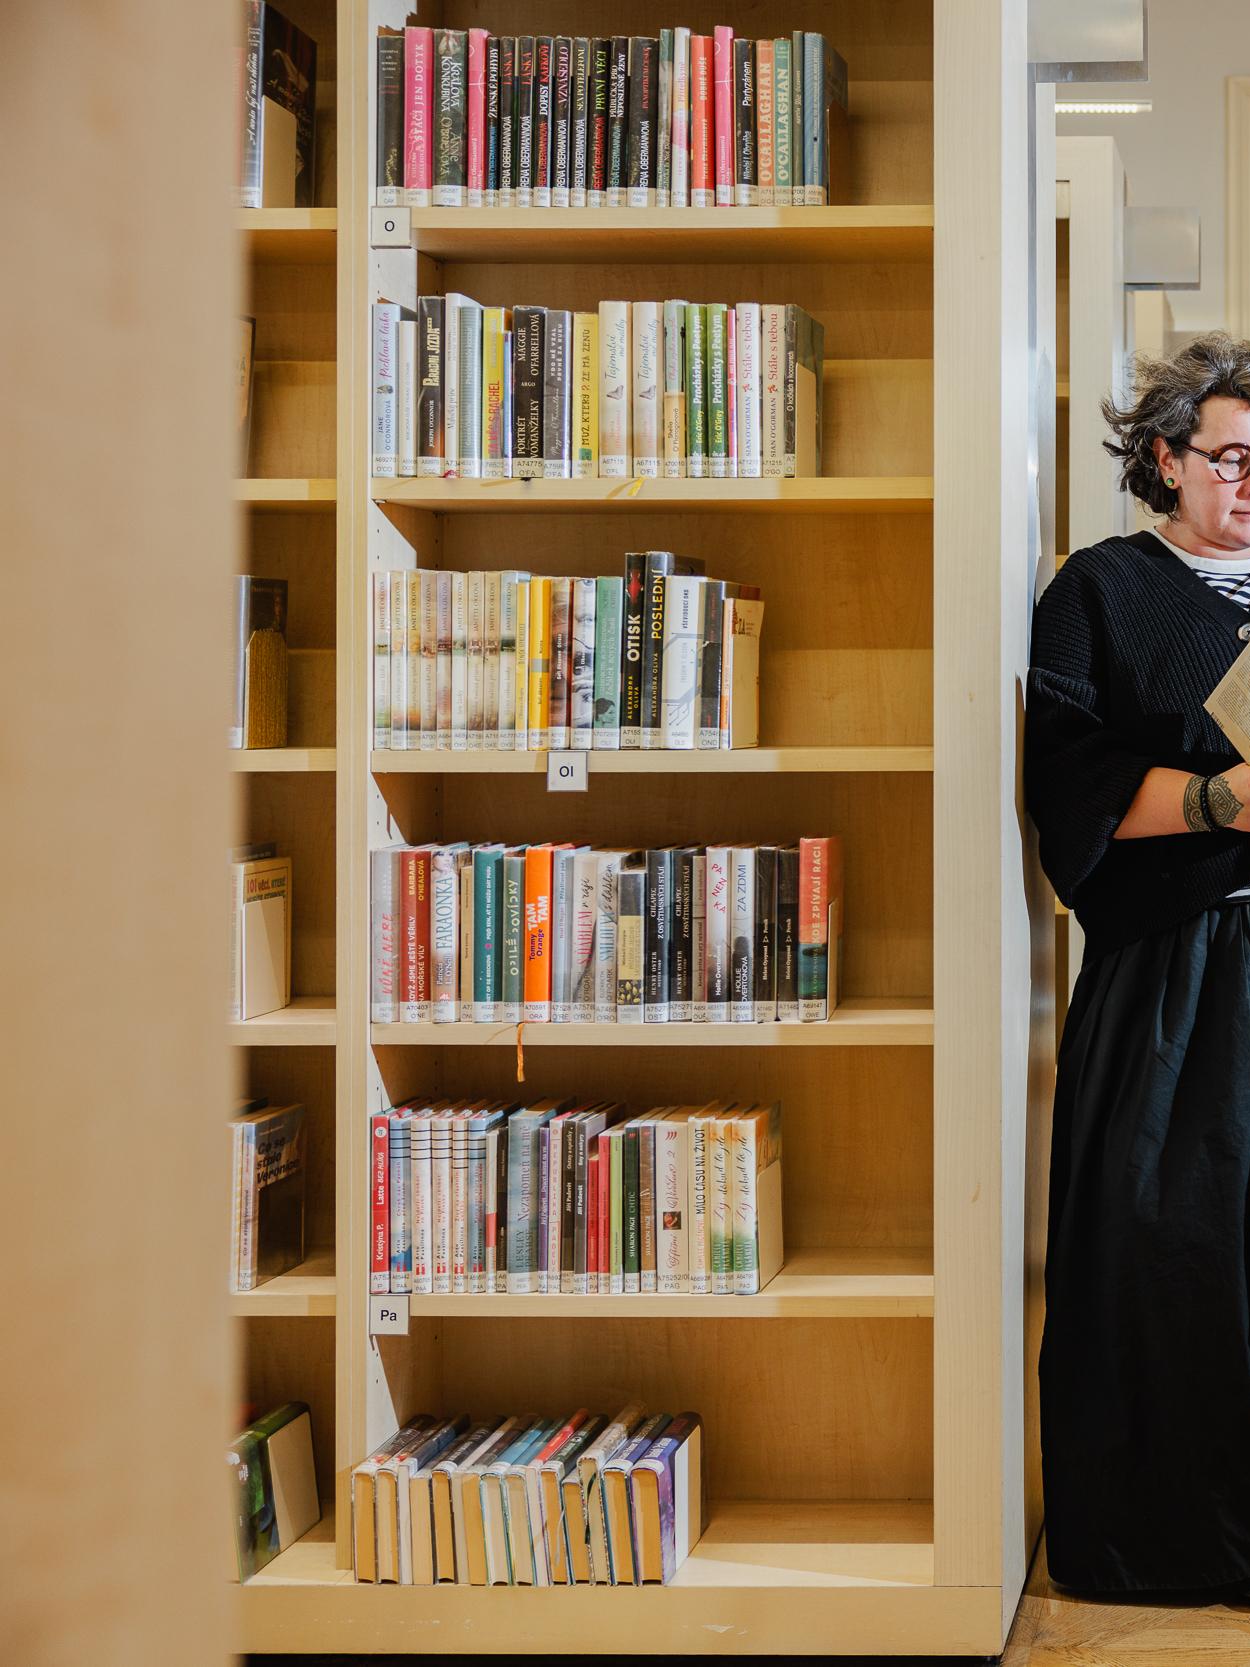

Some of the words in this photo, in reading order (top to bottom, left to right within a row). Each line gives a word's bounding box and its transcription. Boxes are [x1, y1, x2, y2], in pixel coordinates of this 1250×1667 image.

[415, 44, 423, 81] DOTYK
[489, 47, 498, 82] POHYBY
[415, 86, 424, 105] JEN
[742, 61, 752, 106] Partyzánem
[539, 85, 548, 116] DOPISY
[759, 63, 772, 180] O'CALLAGHAN
[777, 68, 789, 180] O'CALLAGHAN
[502, 169, 511, 188] RENA
[520, 169, 530, 188] RENA
[557, 169, 566, 188] RENA
[575, 169, 584, 188] RENA
[640, 171, 649, 188] RENA
[384, 220, 395, 232] O
[693, 314, 703, 349] Peetym
[712, 314, 723, 349] Peetym
[742, 311, 752, 342] tebou
[768, 313, 777, 344] tebou
[742, 352, 752, 379] Stále
[768, 353, 778, 380] Stále
[693, 358, 703, 404] Procházky
[712, 358, 723, 404] Procházky
[516, 416, 526, 454] PORTRÉT
[651, 568, 664, 639] POSLEDNÍ
[627, 614, 641, 662] OTISK
[813, 846, 821, 873] RACI
[656, 866, 665, 884] STÁJÍ
[737, 865, 746, 893] ZDMI
[538, 896, 548, 923] TAM
[737, 897, 746, 912] ZA
[811, 877, 821, 918] ZPÍVAJÍ
[435, 877, 452, 949] FARAONKA
[527, 903, 537, 931] TAM
[407, 941, 416, 963] JEŠTĚ
[529, 934, 537, 960] Tommy
[536, 929, 544, 956] Orange
[408, 965, 416, 983] JSME
[417, 961, 425, 989] MOŘSKÉ
[522, 1145, 530, 1156] na
[693, 1128, 705, 1152] ŽIVOT
[695, 1155, 705, 1166] NA
[694, 1170, 706, 1191] ČASU
[376, 1186, 384, 1205] Latte
[694, 1194, 706, 1214] MÁLO
[376, 1231, 386, 1260] Kristýna
[380, 1310, 398, 1322] Pa
